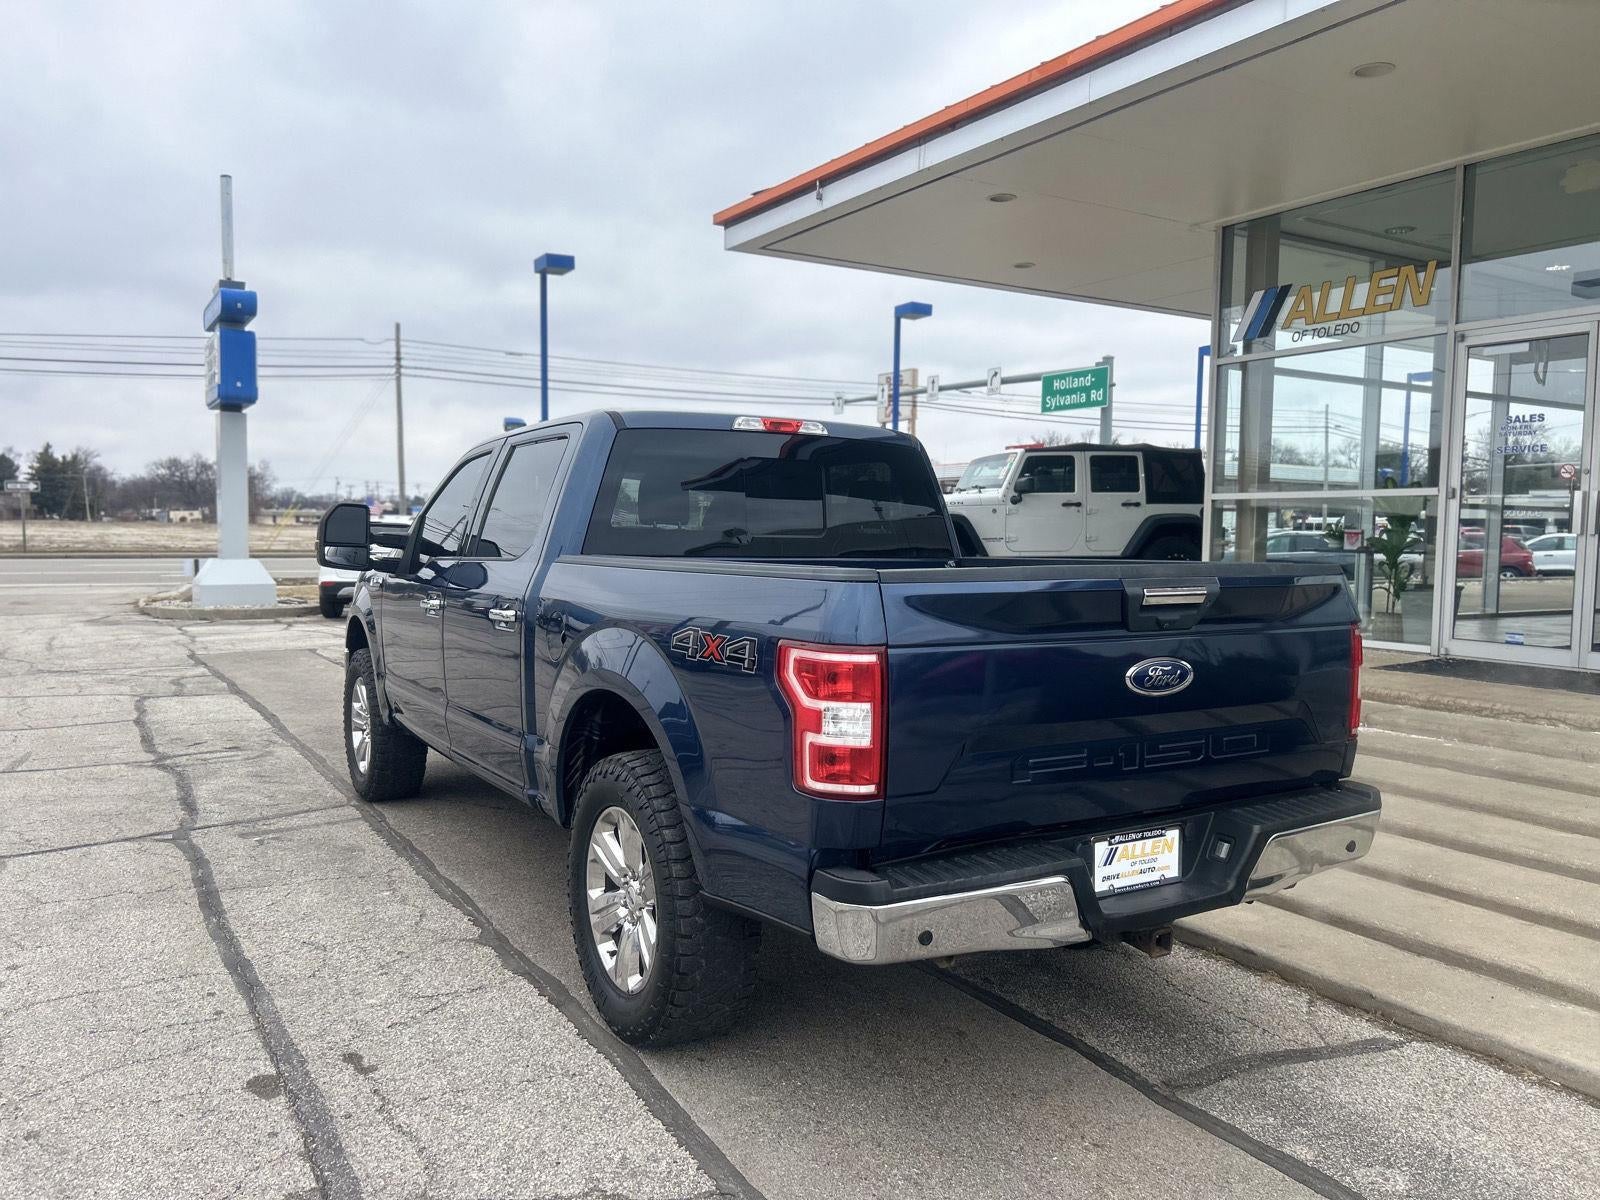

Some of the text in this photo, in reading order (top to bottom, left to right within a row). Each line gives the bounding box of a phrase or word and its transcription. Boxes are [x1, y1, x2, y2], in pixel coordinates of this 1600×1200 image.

[1281, 259, 1438, 331] ALLEN
[1291, 321, 1360, 343] OF TOLEDO
[1053, 373, 1095, 390] Holland-
[1045, 387, 1103, 410] Sylvania Rd
[1505, 412, 1546, 425] SALES
[1496, 443, 1548, 455] SERVICE
[1144, 665, 1181, 689] Ford
[1010, 733, 1270, 784] F-150
[1119, 832, 1136, 842] ALLEN
[1143, 829, 1162, 838] TOLEDO
[1116, 837, 1175, 863] ALLEN
[1130, 857, 1158, 867] OF TOLEDO
